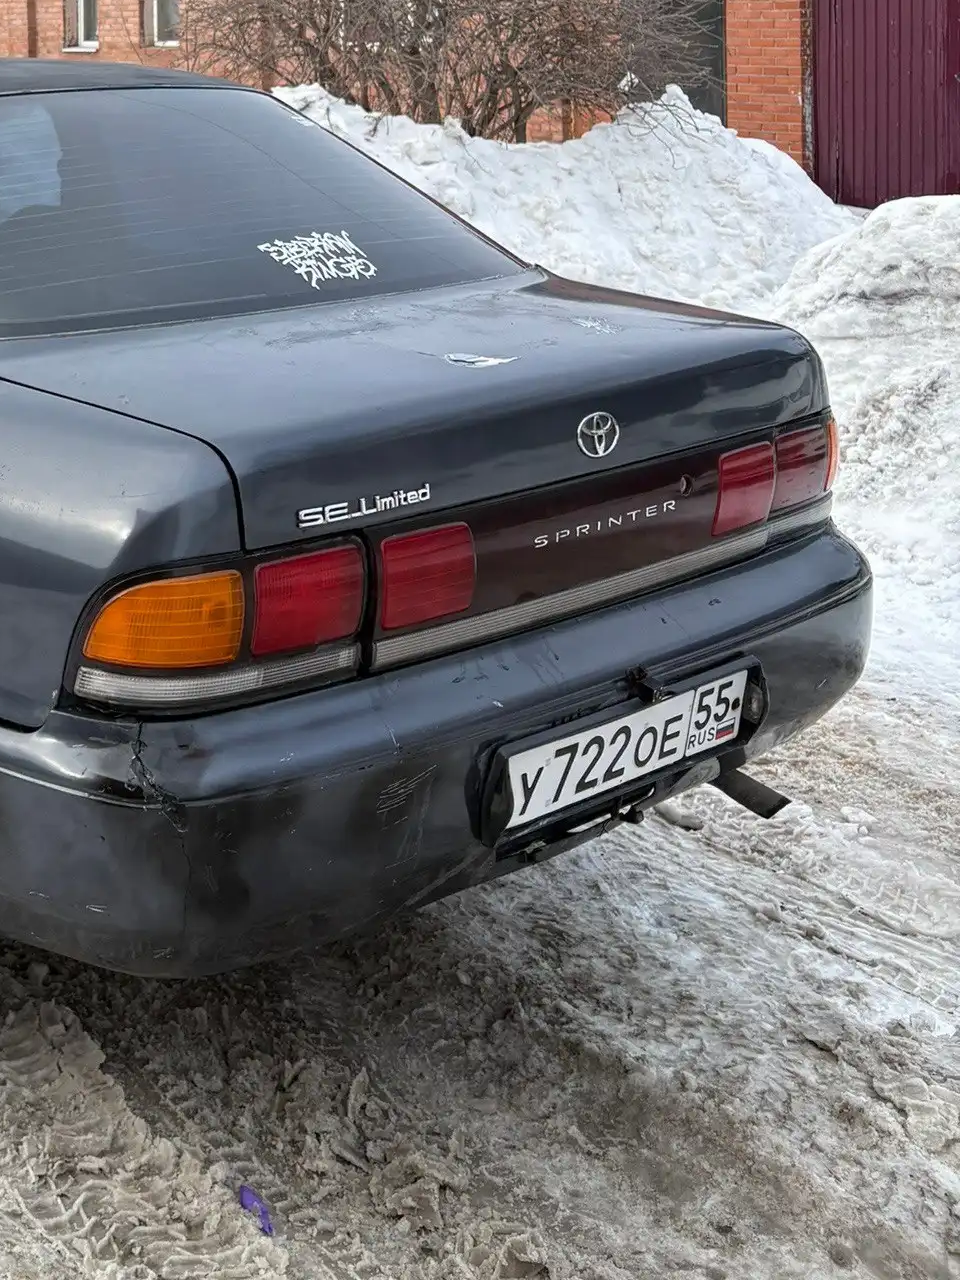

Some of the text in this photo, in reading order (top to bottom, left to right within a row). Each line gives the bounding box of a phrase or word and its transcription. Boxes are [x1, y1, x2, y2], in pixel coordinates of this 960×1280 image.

[534, 500, 676, 548] SPRINTER
[694, 680, 734, 730] 55
[687, 726, 716, 750] RUS
